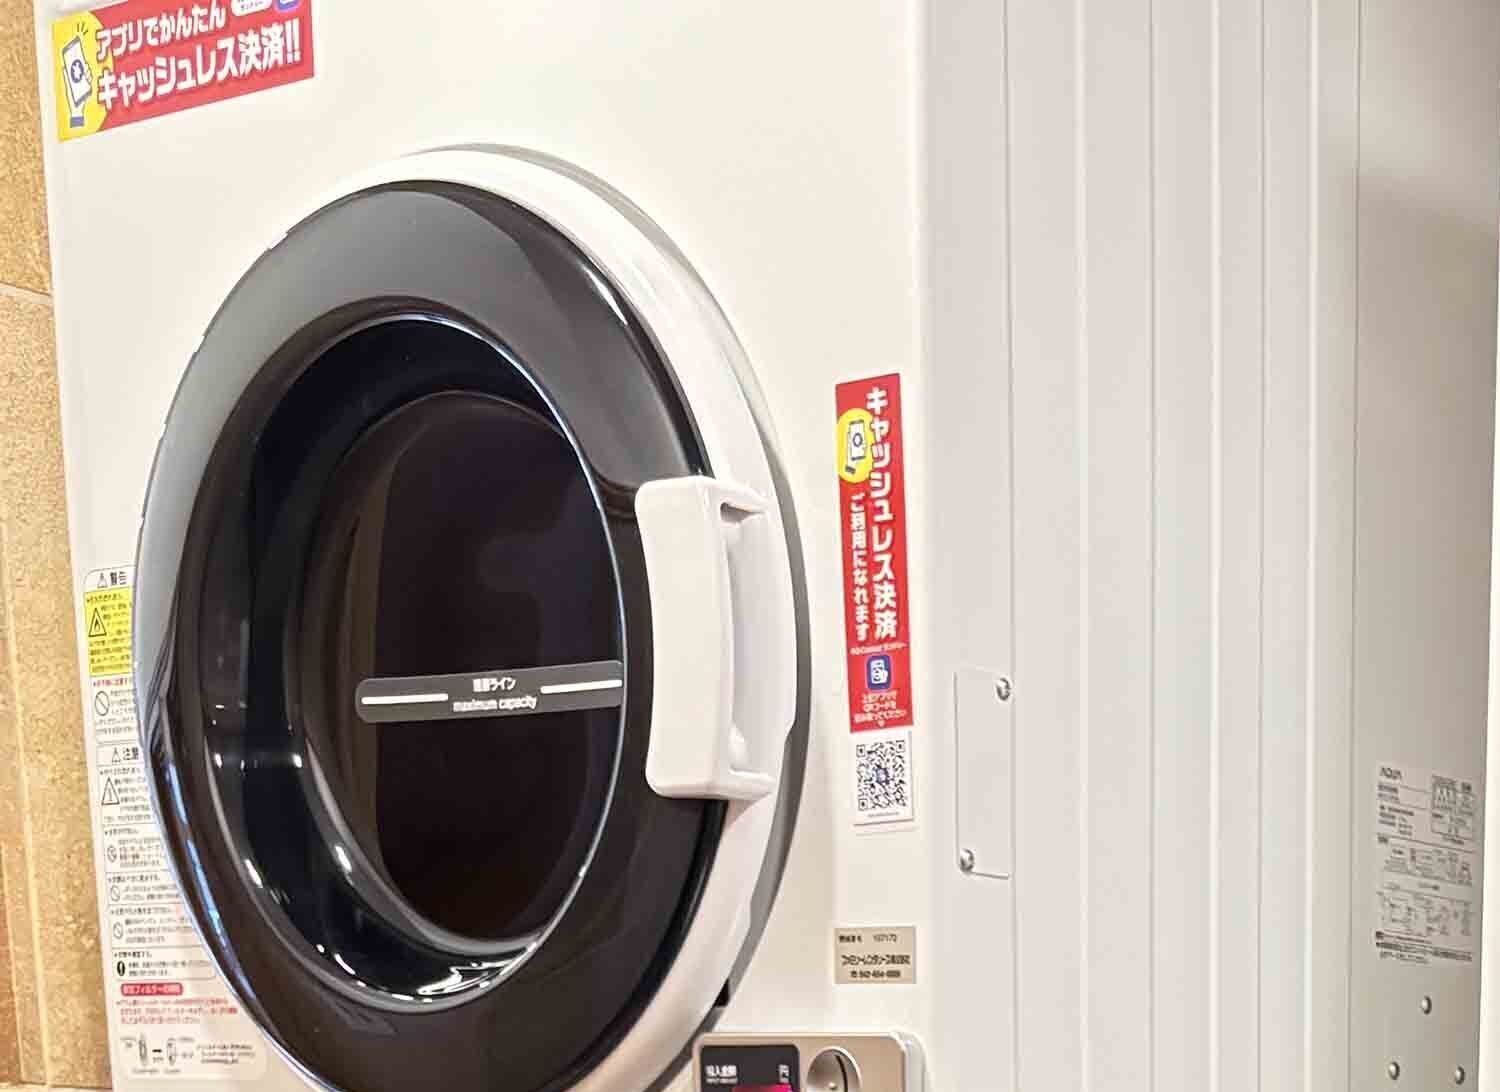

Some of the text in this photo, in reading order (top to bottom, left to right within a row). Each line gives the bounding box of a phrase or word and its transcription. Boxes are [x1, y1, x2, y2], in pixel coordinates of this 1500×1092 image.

[95, 7, 226, 60] アプリでかんたん
[850, 492, 870, 641] ご利用になれます
[866, 387, 897, 640] キャッシュレス決済
